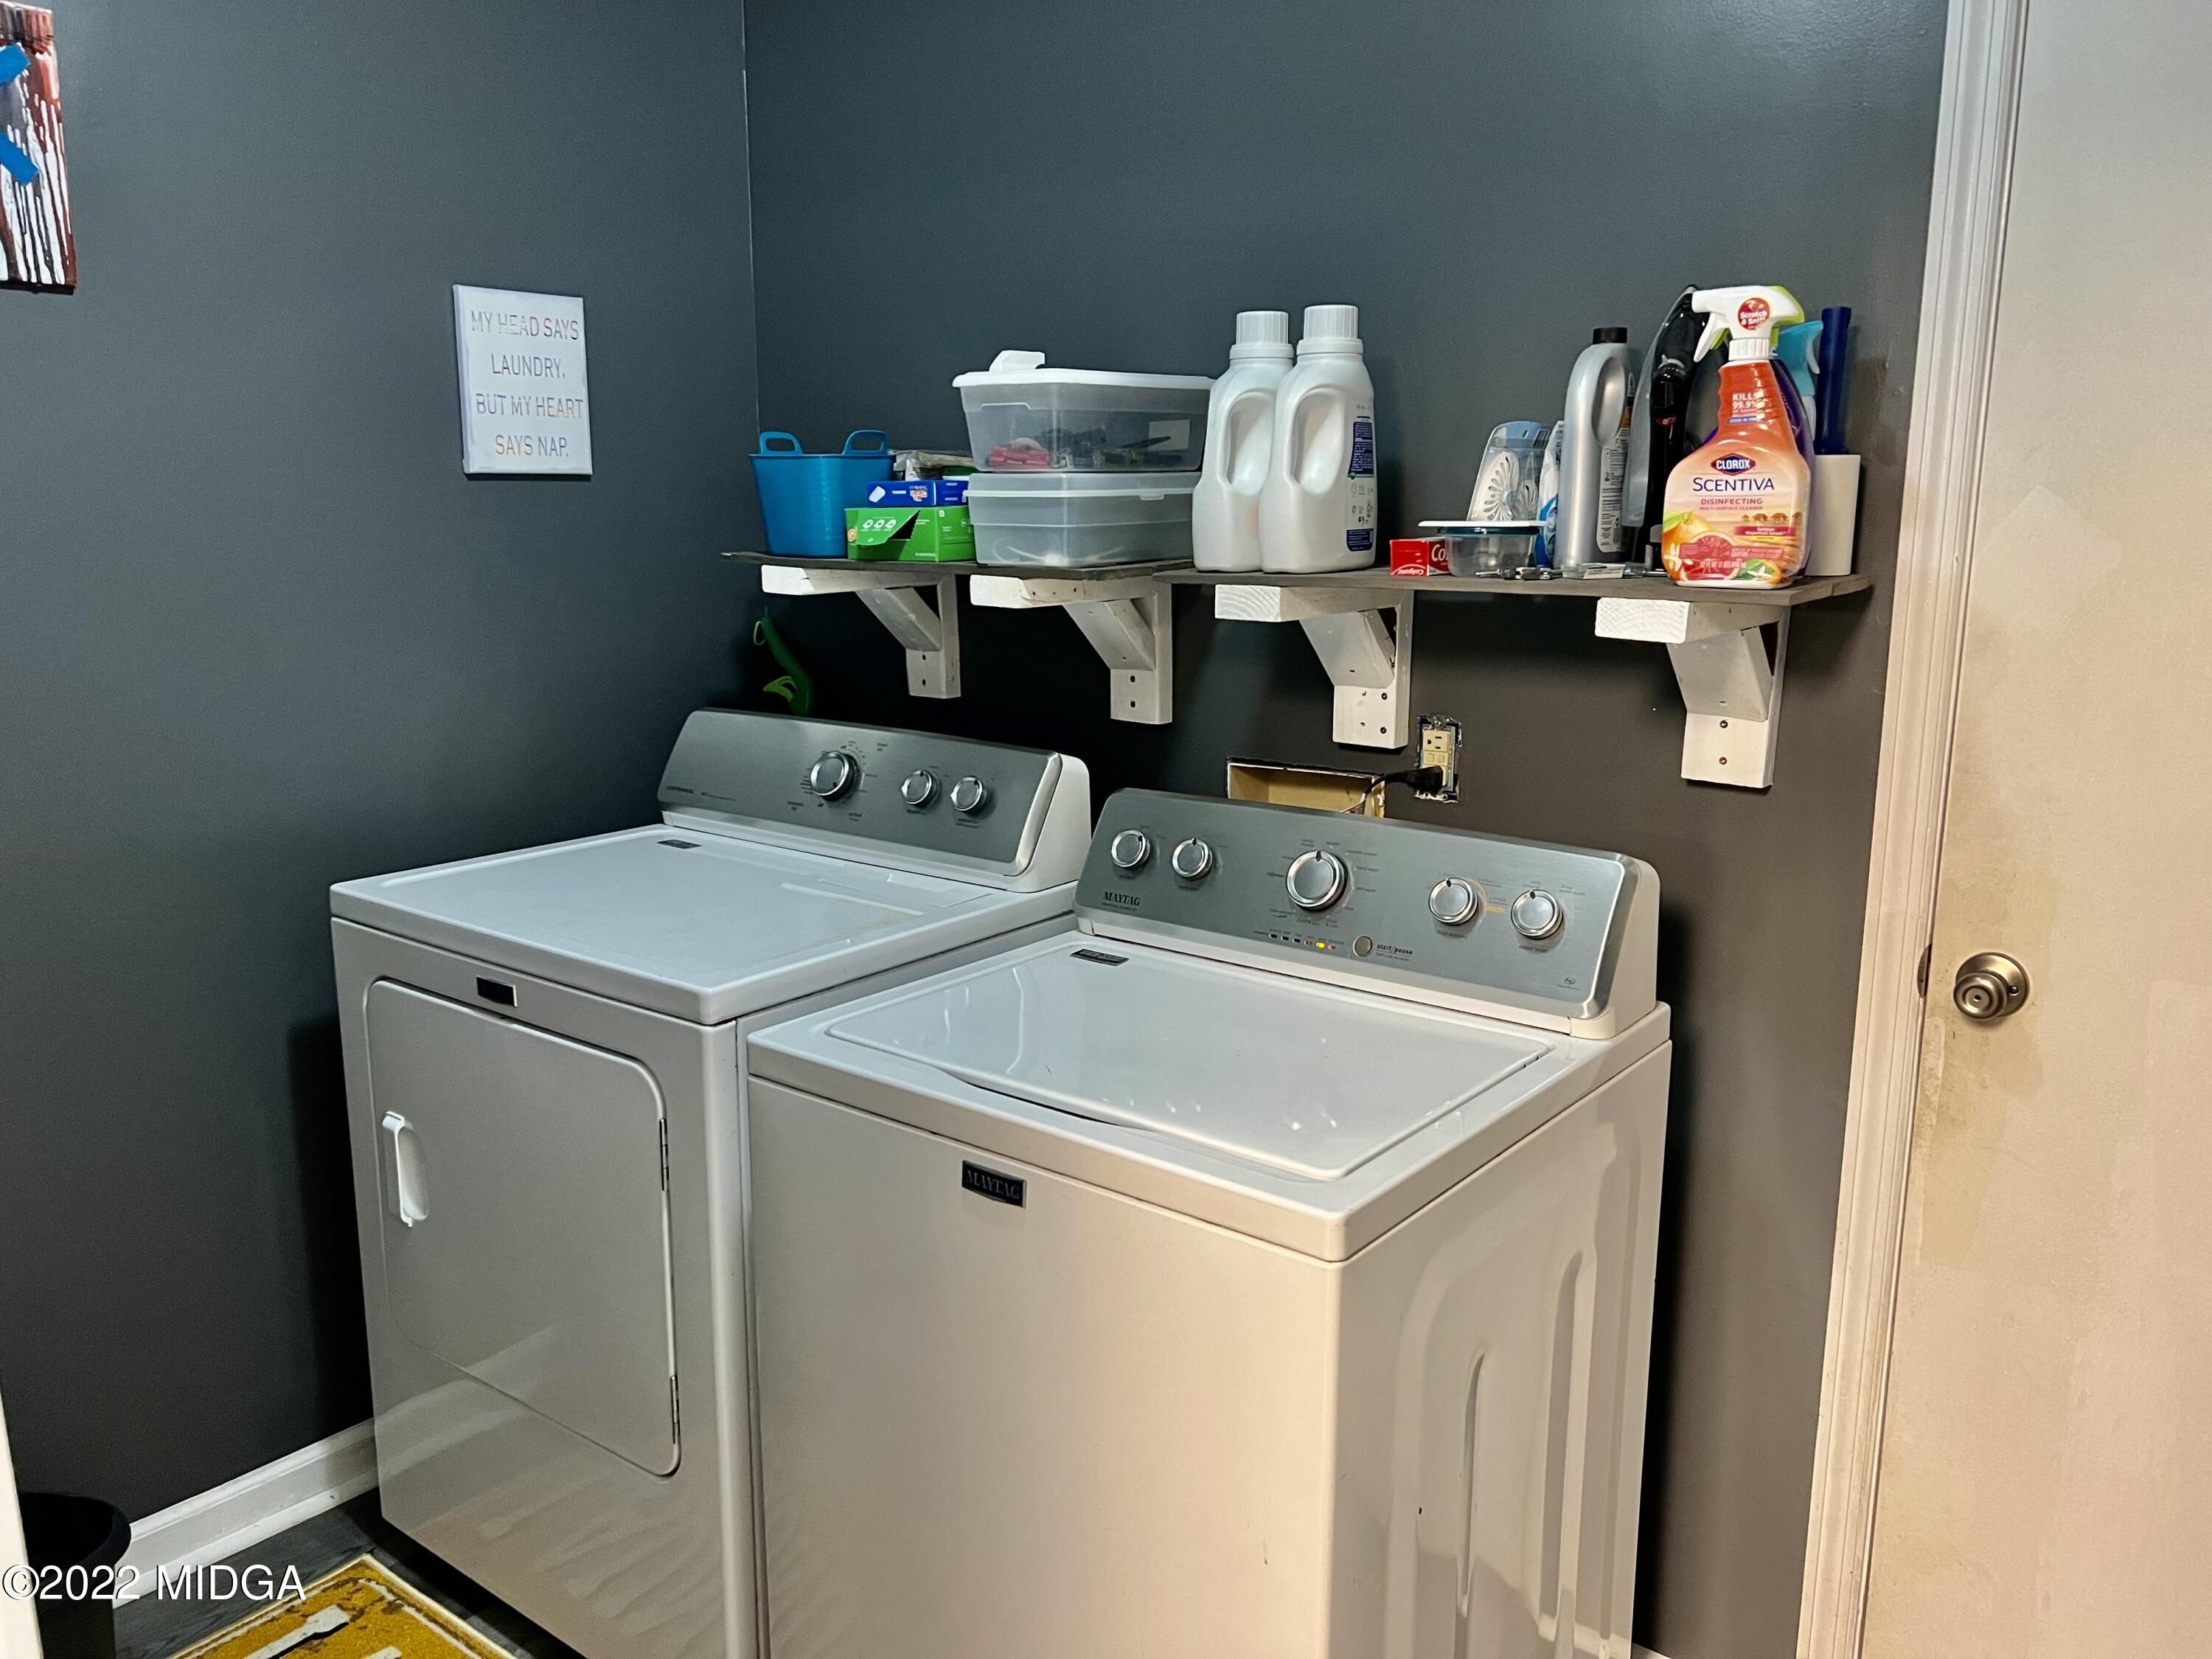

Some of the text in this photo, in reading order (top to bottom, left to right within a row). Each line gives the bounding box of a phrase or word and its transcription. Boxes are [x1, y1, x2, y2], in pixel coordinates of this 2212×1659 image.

[471, 310, 580, 341] MY HEAD SAYS
[476, 393, 584, 419] BUT MY HEART
[495, 434, 569, 458] SAYS NAP.
[1716, 459, 1750, 470] CLOROX
[1102, 891, 1141, 906] MAYTAG
[966, 1169, 1020, 1200] MAYTAG
